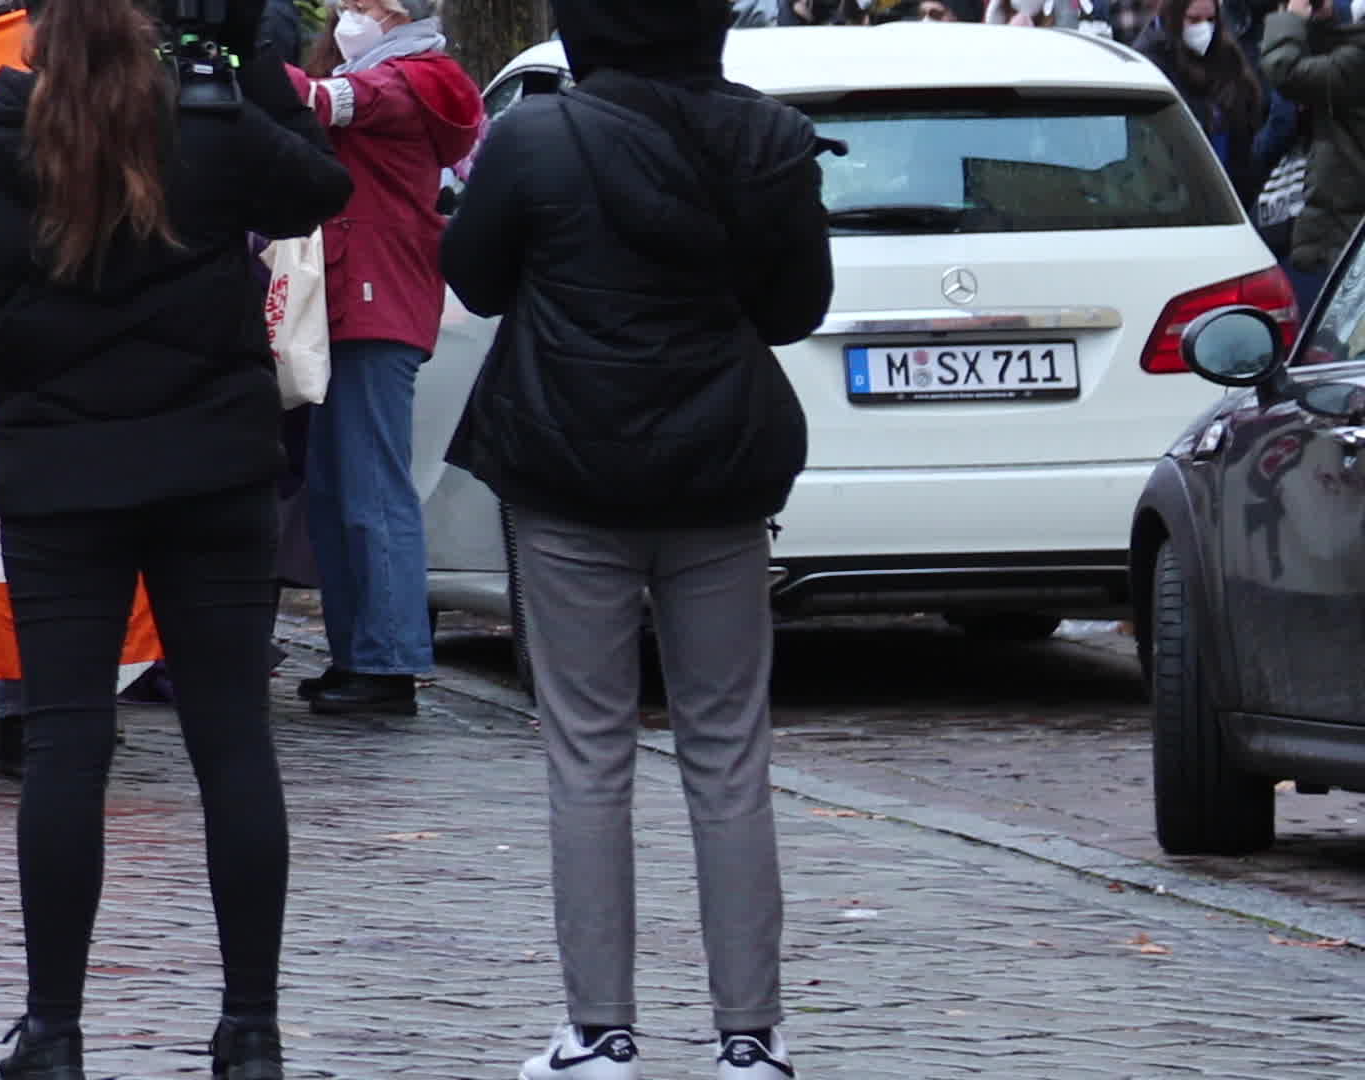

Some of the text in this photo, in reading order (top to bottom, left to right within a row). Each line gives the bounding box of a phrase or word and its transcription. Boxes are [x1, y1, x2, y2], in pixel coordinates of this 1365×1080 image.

[886, 352, 910, 387] M
[937, 351, 984, 386] SX
[993, 349, 1063, 384] 711
